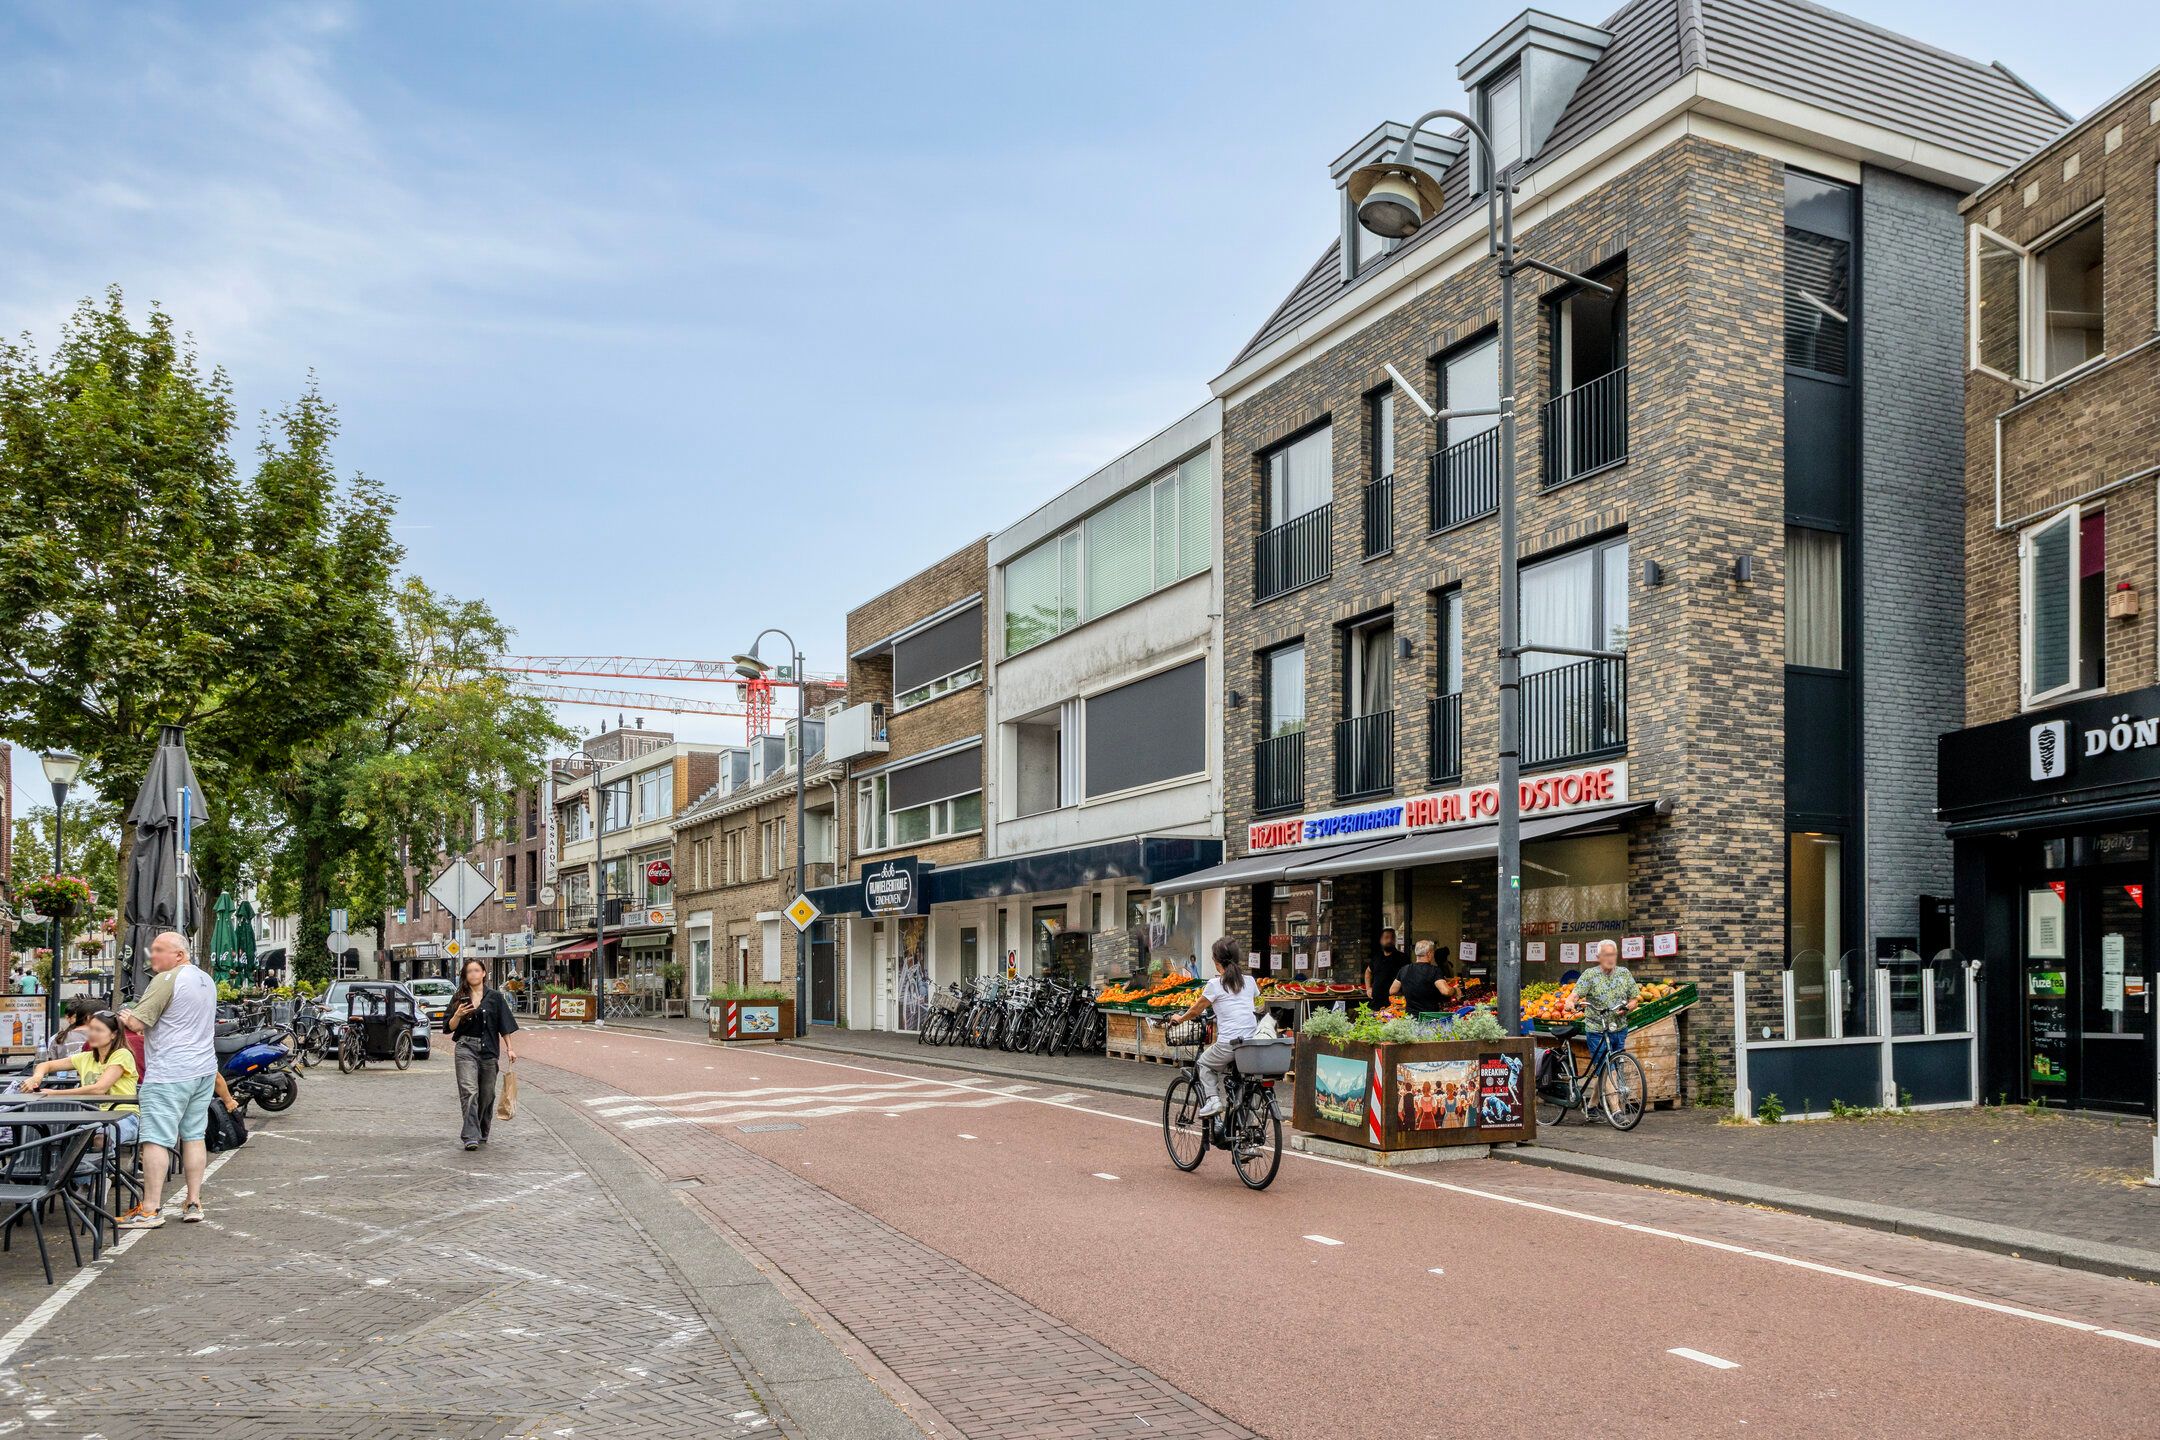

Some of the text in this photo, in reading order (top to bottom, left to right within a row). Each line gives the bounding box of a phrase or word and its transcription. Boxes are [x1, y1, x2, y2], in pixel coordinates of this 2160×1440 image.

[696, 663, 724, 671] WOLFF
[2084, 713, 2160, 757] DÖN
[1316, 806, 1403, 838] SUPERMARKT
[1406, 794, 1466, 828] HALAL
[1469, 768, 1614, 818] FODSTORE
[1569, 919, 1627, 933] SUPERMARKT
[1481, 1068, 1508, 1076] BREAKING
